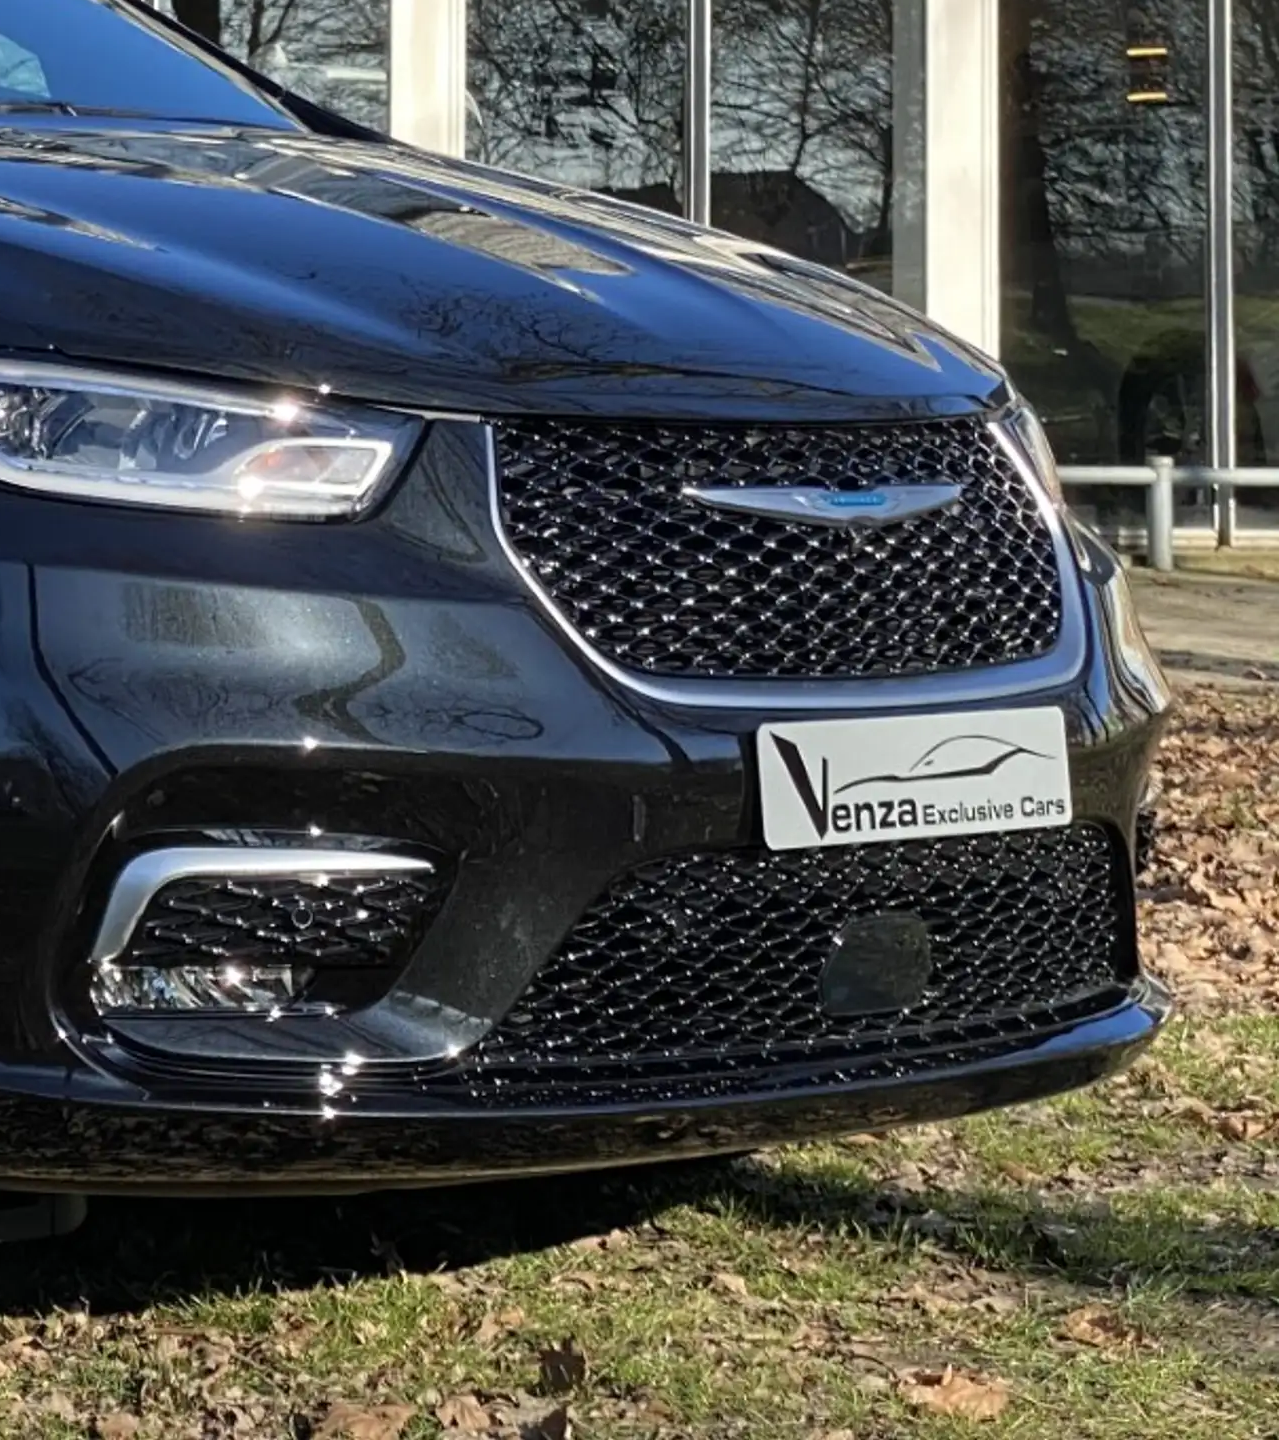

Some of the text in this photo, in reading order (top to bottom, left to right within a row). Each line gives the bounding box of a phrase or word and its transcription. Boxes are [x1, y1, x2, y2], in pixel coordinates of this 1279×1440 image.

[770, 731, 1065, 840] Venza Exclusive Cars
